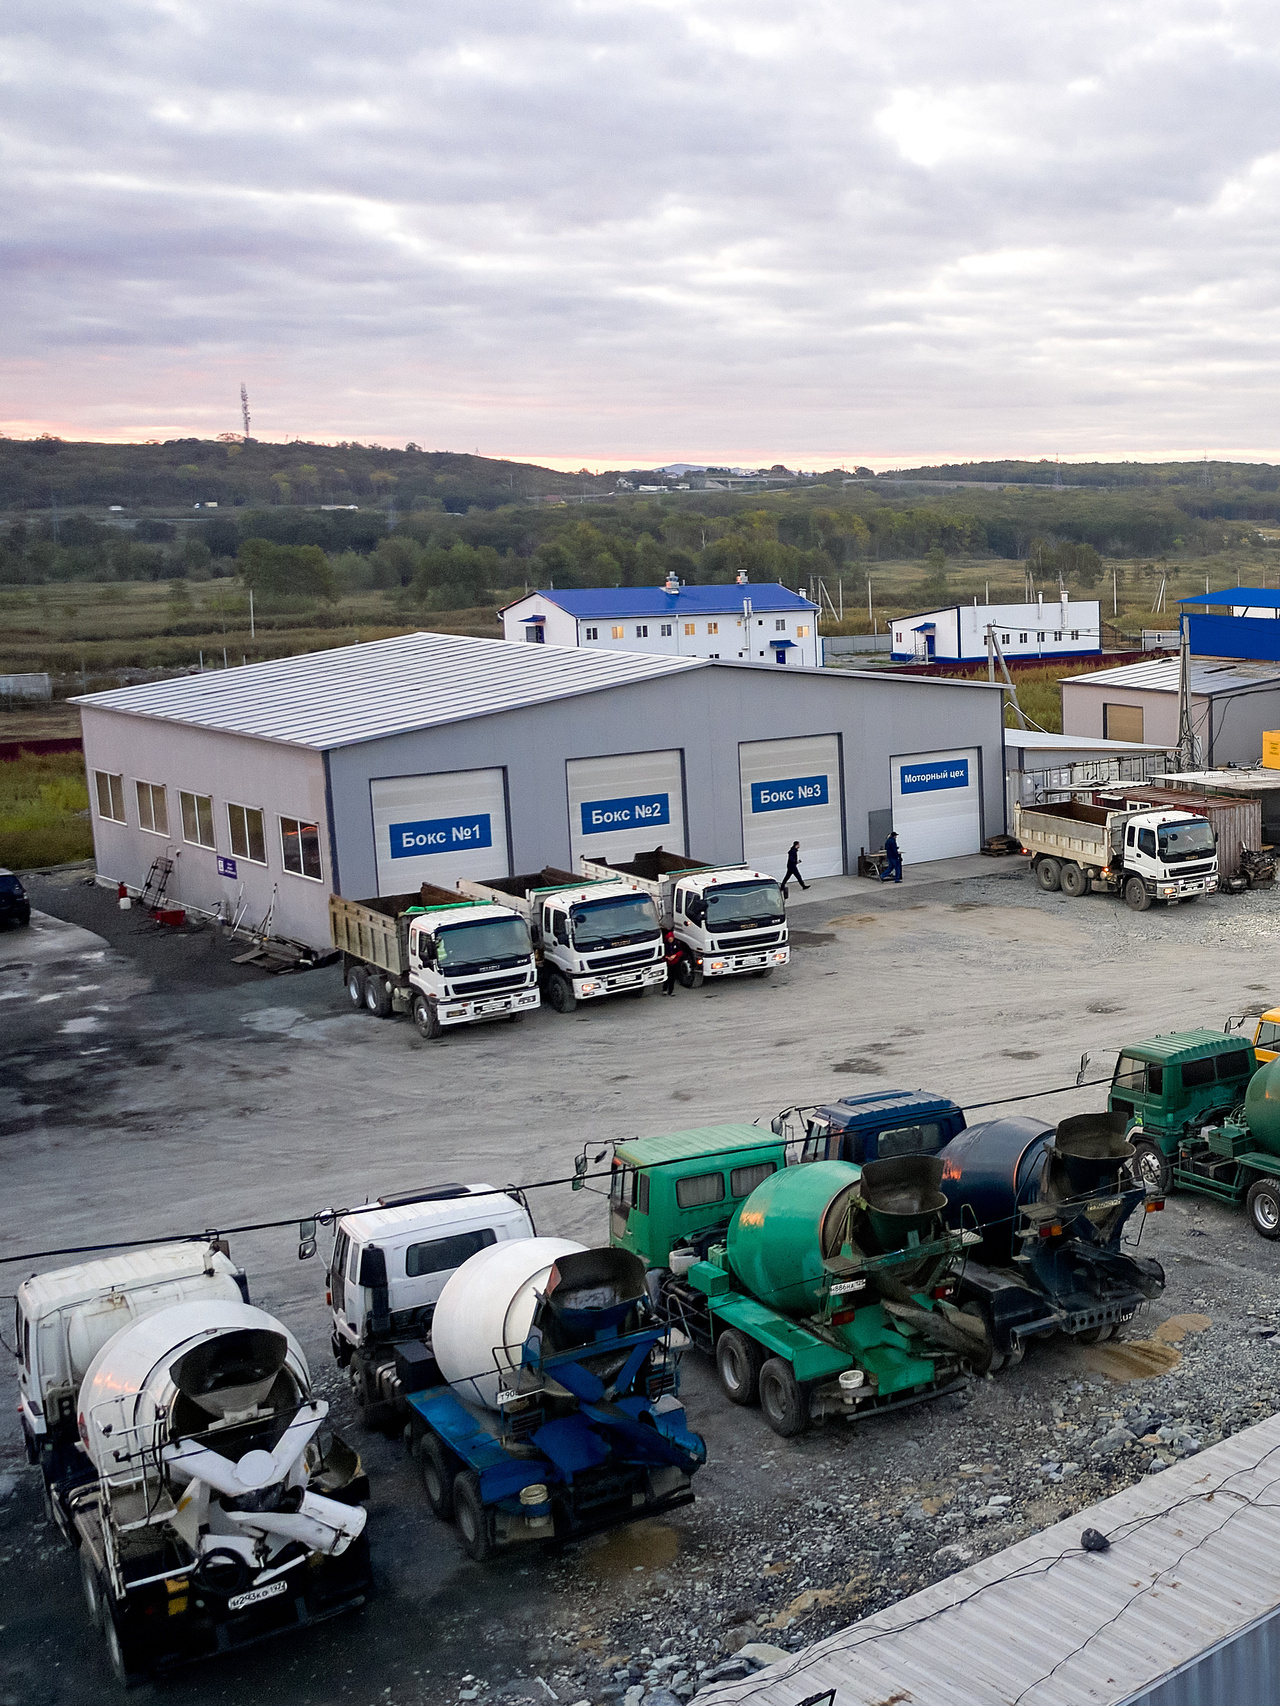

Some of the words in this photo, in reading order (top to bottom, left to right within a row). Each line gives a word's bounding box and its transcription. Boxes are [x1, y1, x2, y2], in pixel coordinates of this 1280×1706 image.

[904, 769, 948, 783] Моторный
[949, 769, 965, 779] цех
[760, 790, 794, 804] Бокс
[798, 784, 821, 799] №3
[591, 810, 630, 825] Бокс
[635, 803, 662, 819] №2
[402, 831, 447, 848] Бокс
[452, 824, 480, 842] №1
